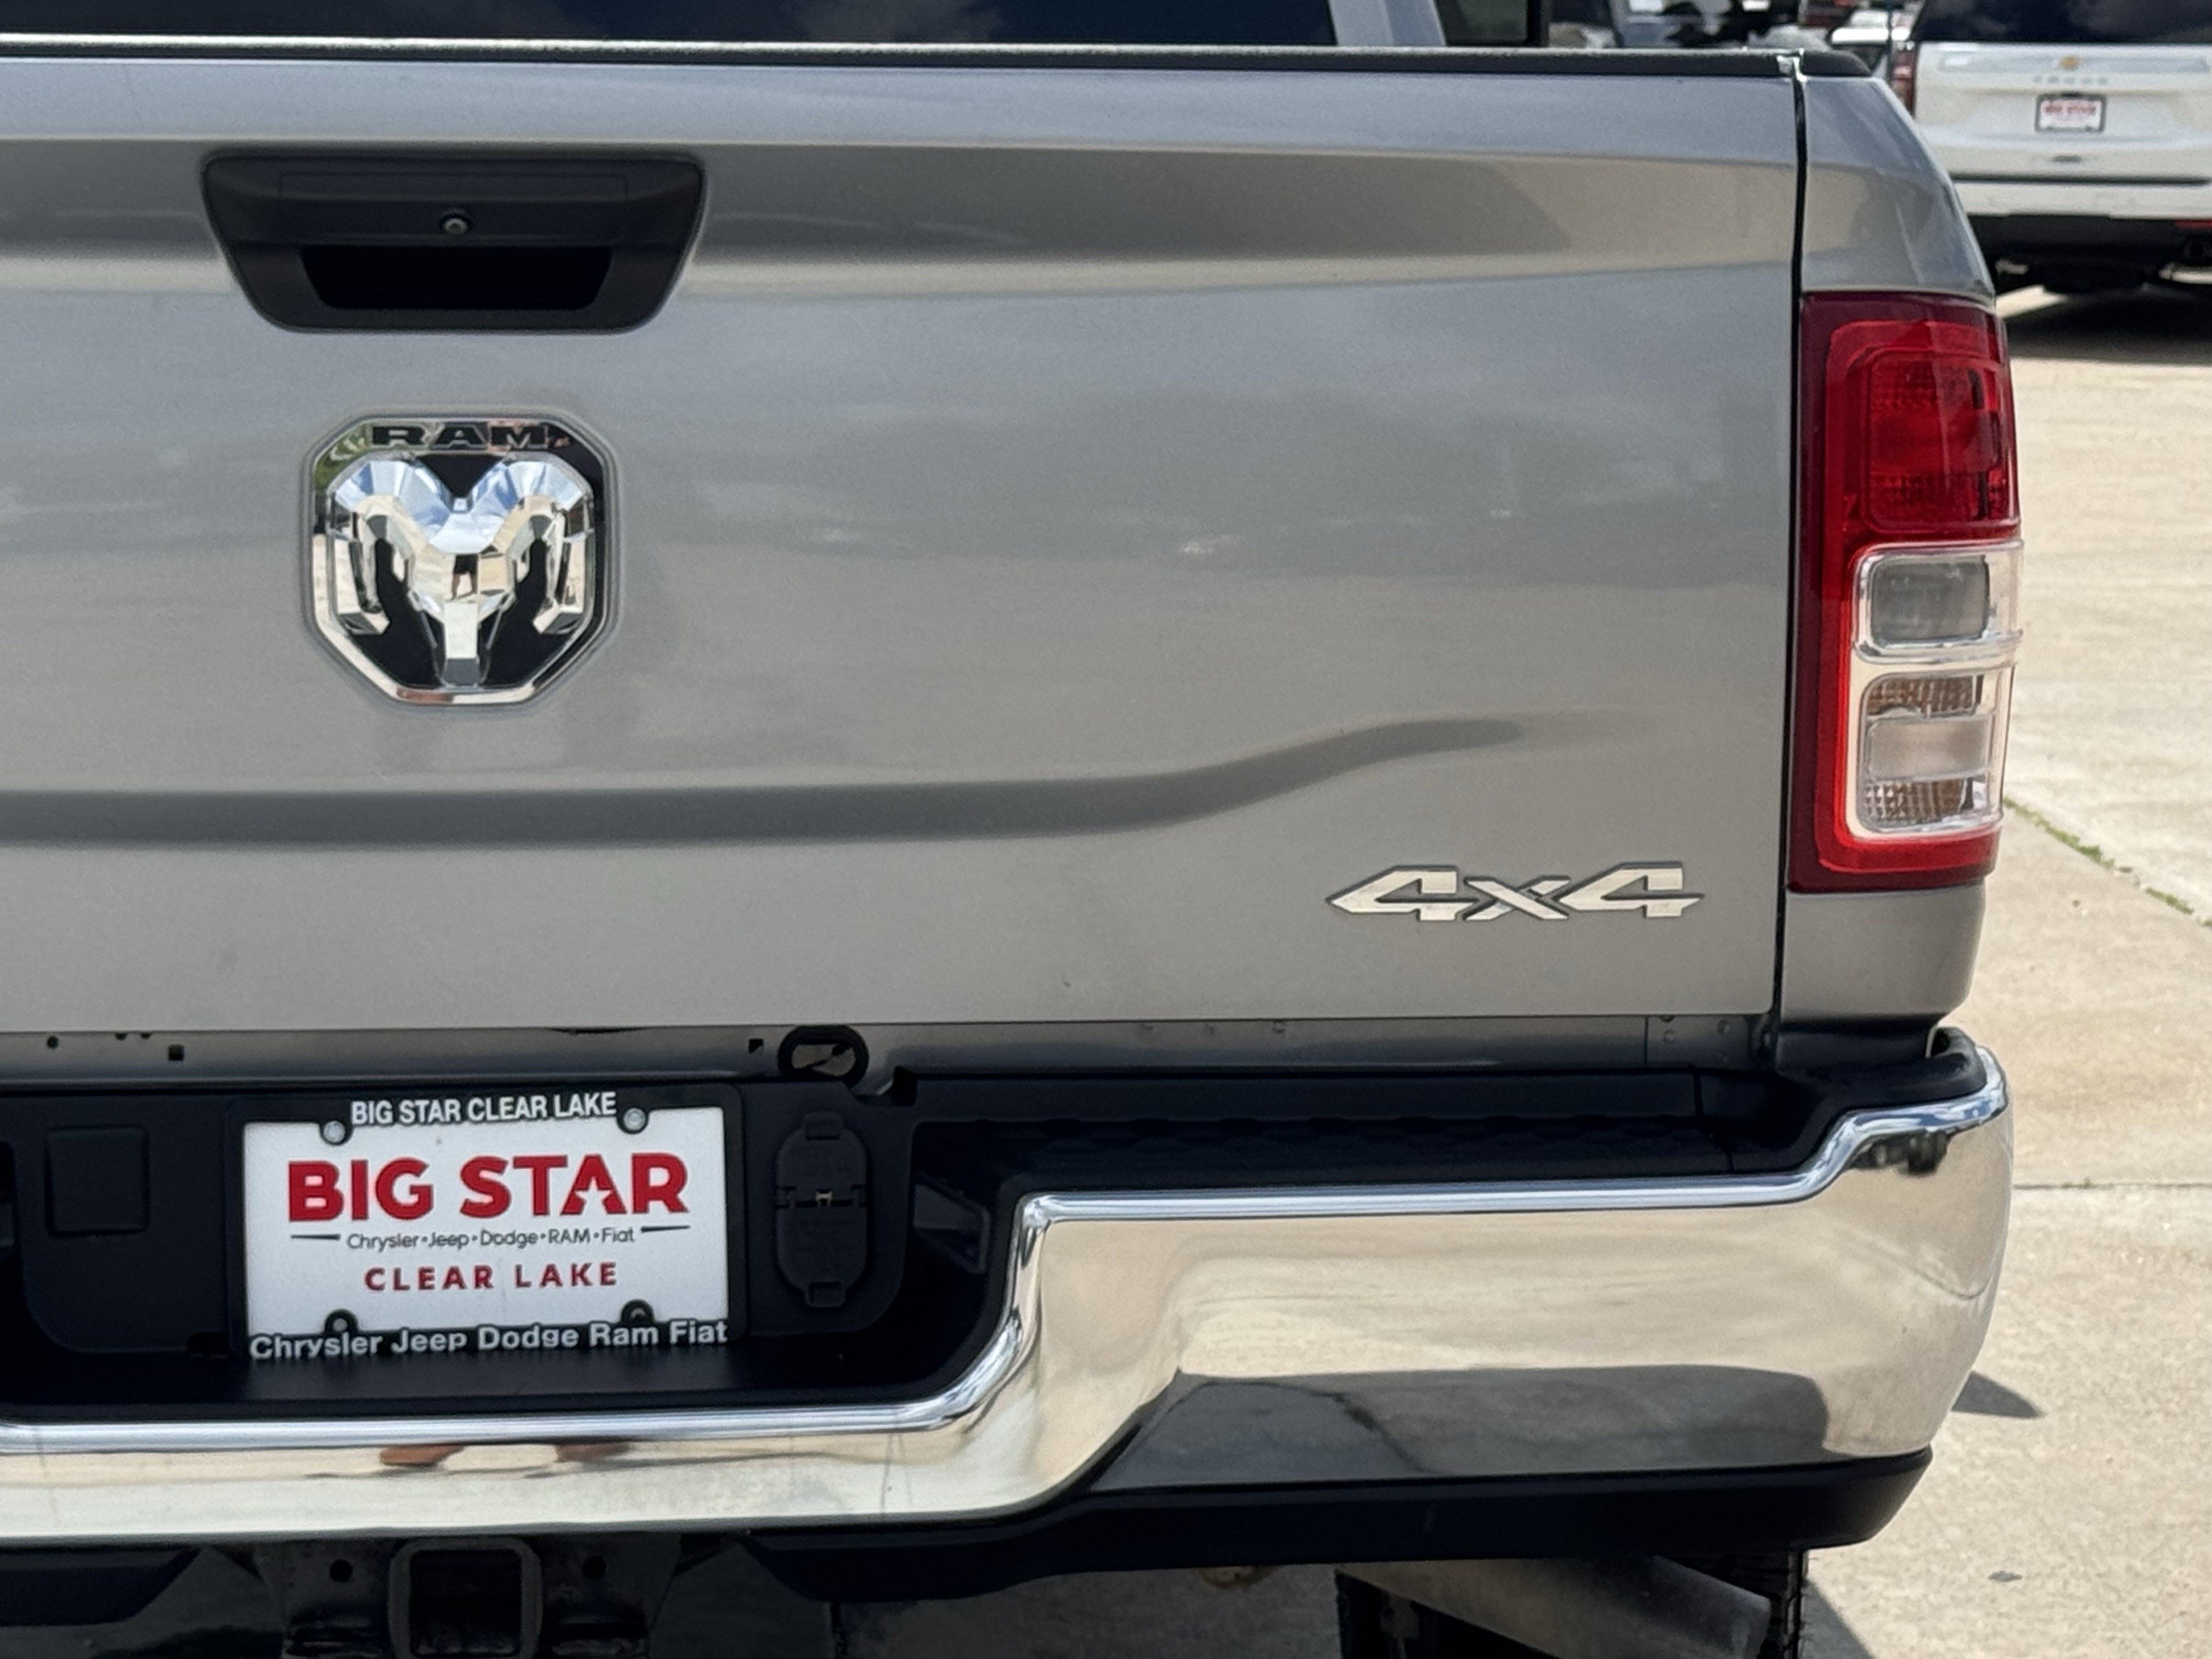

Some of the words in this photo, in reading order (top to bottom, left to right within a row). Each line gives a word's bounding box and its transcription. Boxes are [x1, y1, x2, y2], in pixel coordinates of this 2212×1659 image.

[371, 425, 549, 449] RAM
[1326, 861, 1705, 921] 4x4
[351, 1101, 393, 1126] BIG
[398, 1098, 461, 1124] STAR
[468, 1095, 548, 1121] CLEAR
[554, 1092, 617, 1118] LAKE
[288, 1158, 433, 1222] BIG
[459, 1152, 689, 1219] STAR
[347, 1232, 420, 1252] Chrysler
[428, 1232, 470, 1250] Jeep
[480, 1228, 538, 1249] Dodge
[549, 1228, 590, 1245] RAM
[602, 1226, 635, 1243] Fiat
[364, 1265, 494, 1291] CLEAR
[516, 1262, 618, 1288] LAKE
[249, 1331, 383, 1361] Chrysler
[391, 1330, 468, 1357] Jeep
[477, 1323, 579, 1351] Dodge
[589, 1323, 659, 1346] Ram
[669, 1319, 729, 1345] Fiat
